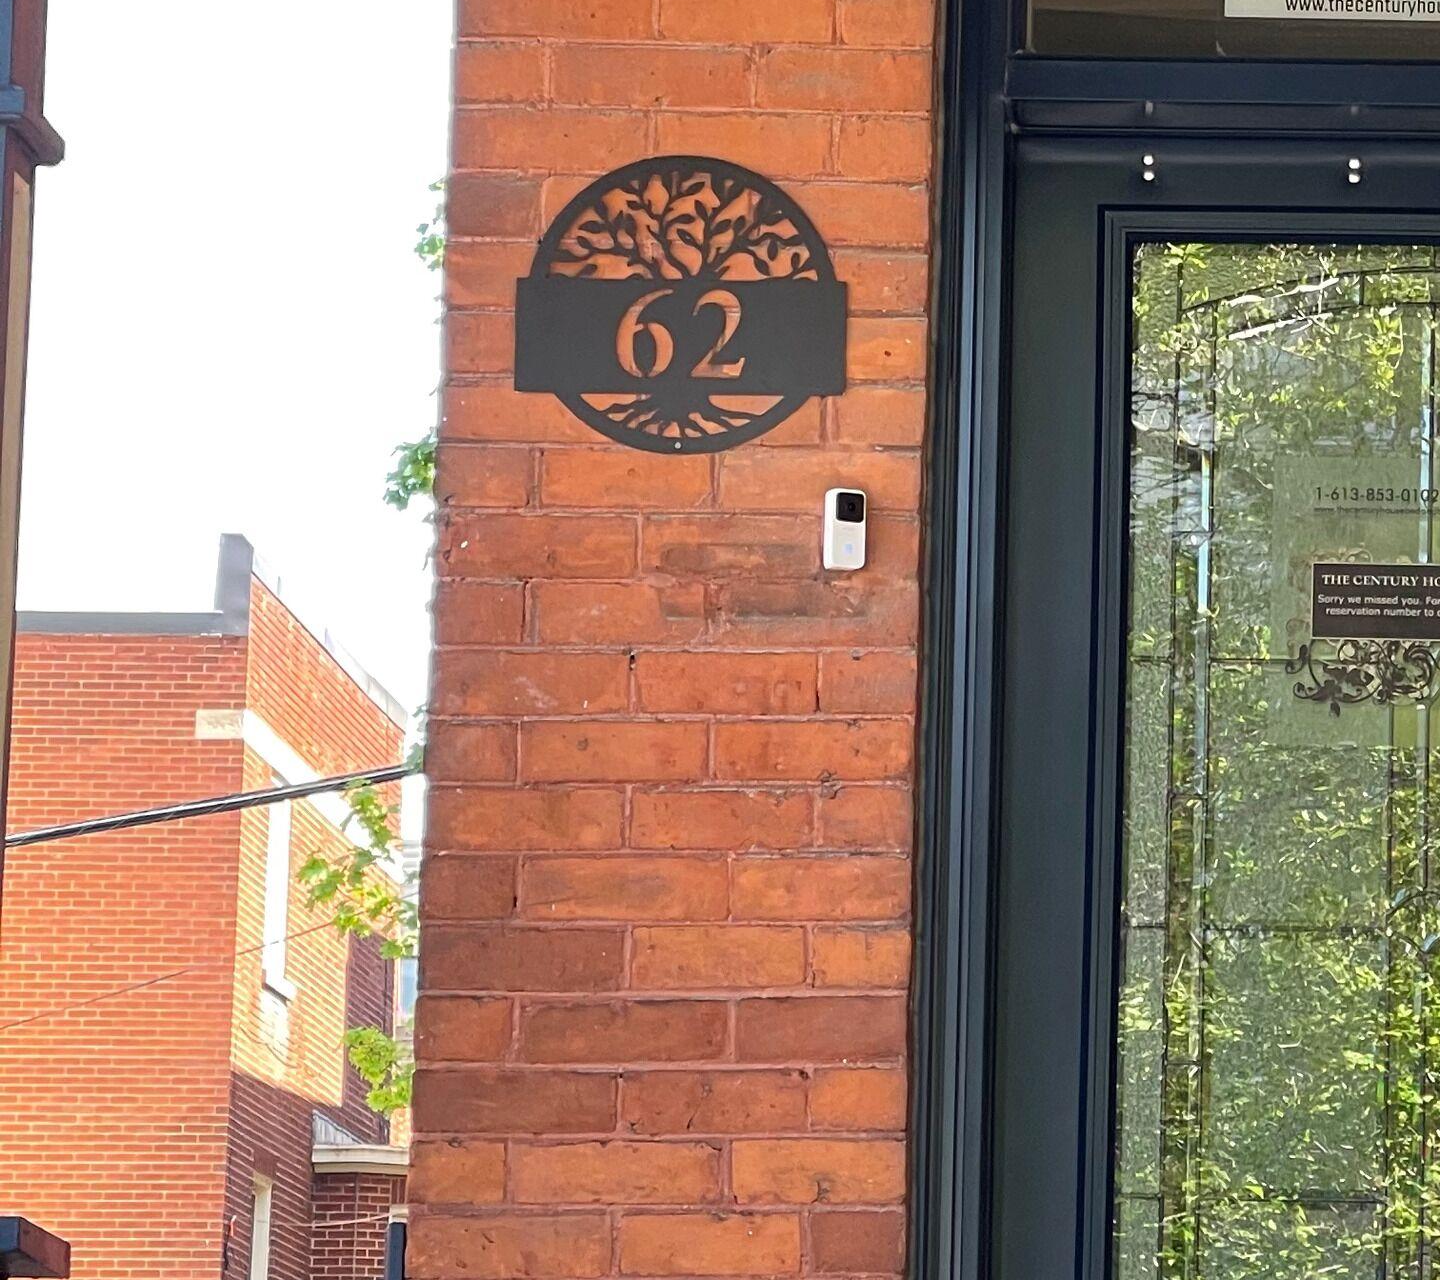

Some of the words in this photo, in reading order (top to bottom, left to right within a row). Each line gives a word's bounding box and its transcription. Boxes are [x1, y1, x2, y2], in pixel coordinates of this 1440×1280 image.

[615, 288, 746, 379] 62
[1315, 486, 1440, 502] 1-613-853-0102
[1322, 574, 1350, 585] THE
[1352, 575, 1419, 587] CENTURY
[1317, 594, 1344, 605] Sorry
[1347, 596, 1361, 604] we
[1364, 595, 1399, 605] missed
[1425, 596, 1440, 605] For
[1325, 607, 1381, 616] reservation
[1383, 608, 1420, 617] number
[1424, 609, 1434, 617] to
